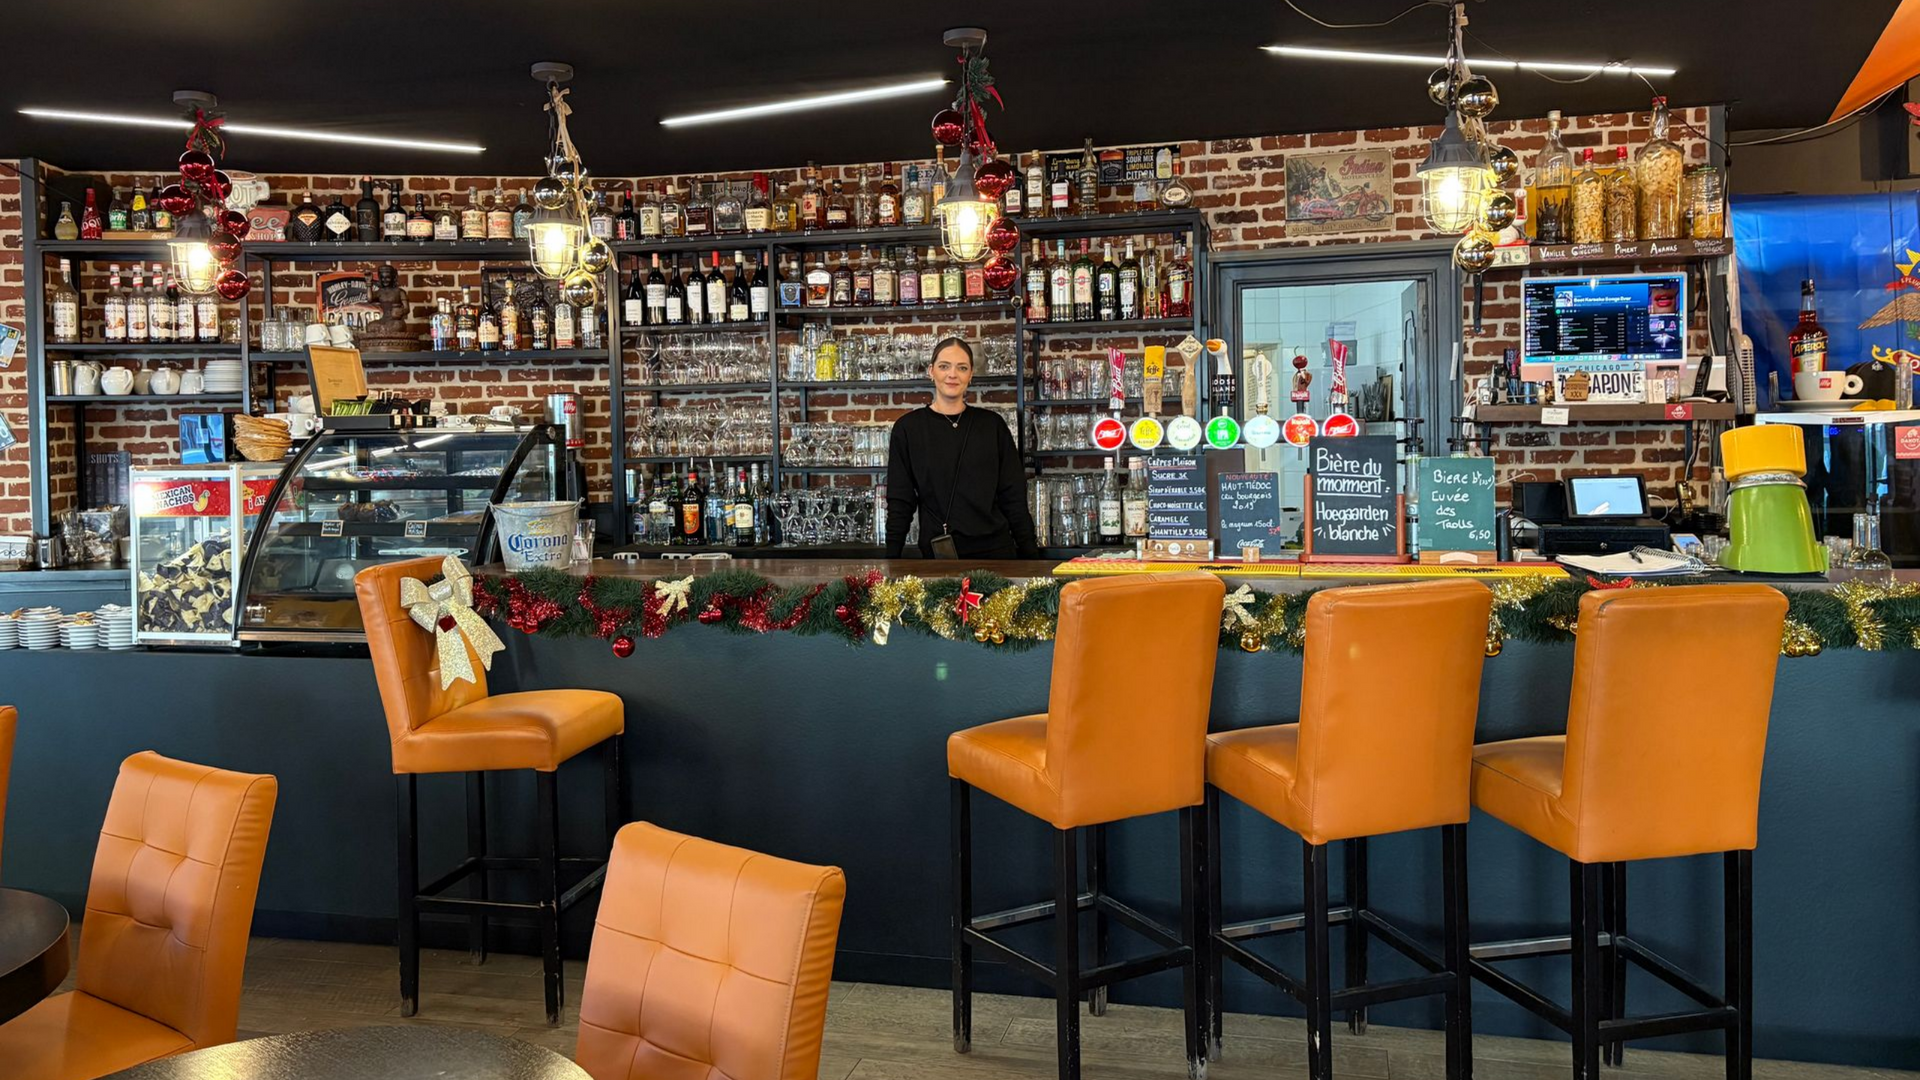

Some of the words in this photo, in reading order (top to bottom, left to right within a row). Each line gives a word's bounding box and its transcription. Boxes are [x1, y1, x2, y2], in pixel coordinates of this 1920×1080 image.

[1126, 156, 1142, 164] SOUR
[1126, 162, 1154, 170] LIMONADE
[1339, 155, 1386, 175] Indian
[1539, 247, 1566, 258] VANILLE
[1614, 243, 1638, 254] PIMENT
[1650, 242, 1678, 254] ANANAS
[1794, 342, 1825, 354] APEROL
[1112, 364, 1122, 394] Bud
[1333, 358, 1344, 388] Bud
[1588, 373, 1641, 395] APONE
[91, 454, 119, 464] SHOTS
[1317, 447, 1360, 473] Bière
[1363, 458, 1382, 476] du
[156, 493, 195, 510] NACHOS
[1236, 491, 1272, 503] bourgeois
[1232, 500, 1253, 510] 2019
[1436, 505, 1456, 516] des
[1149, 513, 1178, 522] CARAMEL
[1316, 501, 1388, 526] Hoegaarden
[1150, 526, 1187, 536] CHANTILLY
[1329, 524, 1379, 541] blanche
[1469, 529, 1491, 541] 6,50
[508, 534, 568, 554] Corona
[524, 551, 562, 562] Extra
